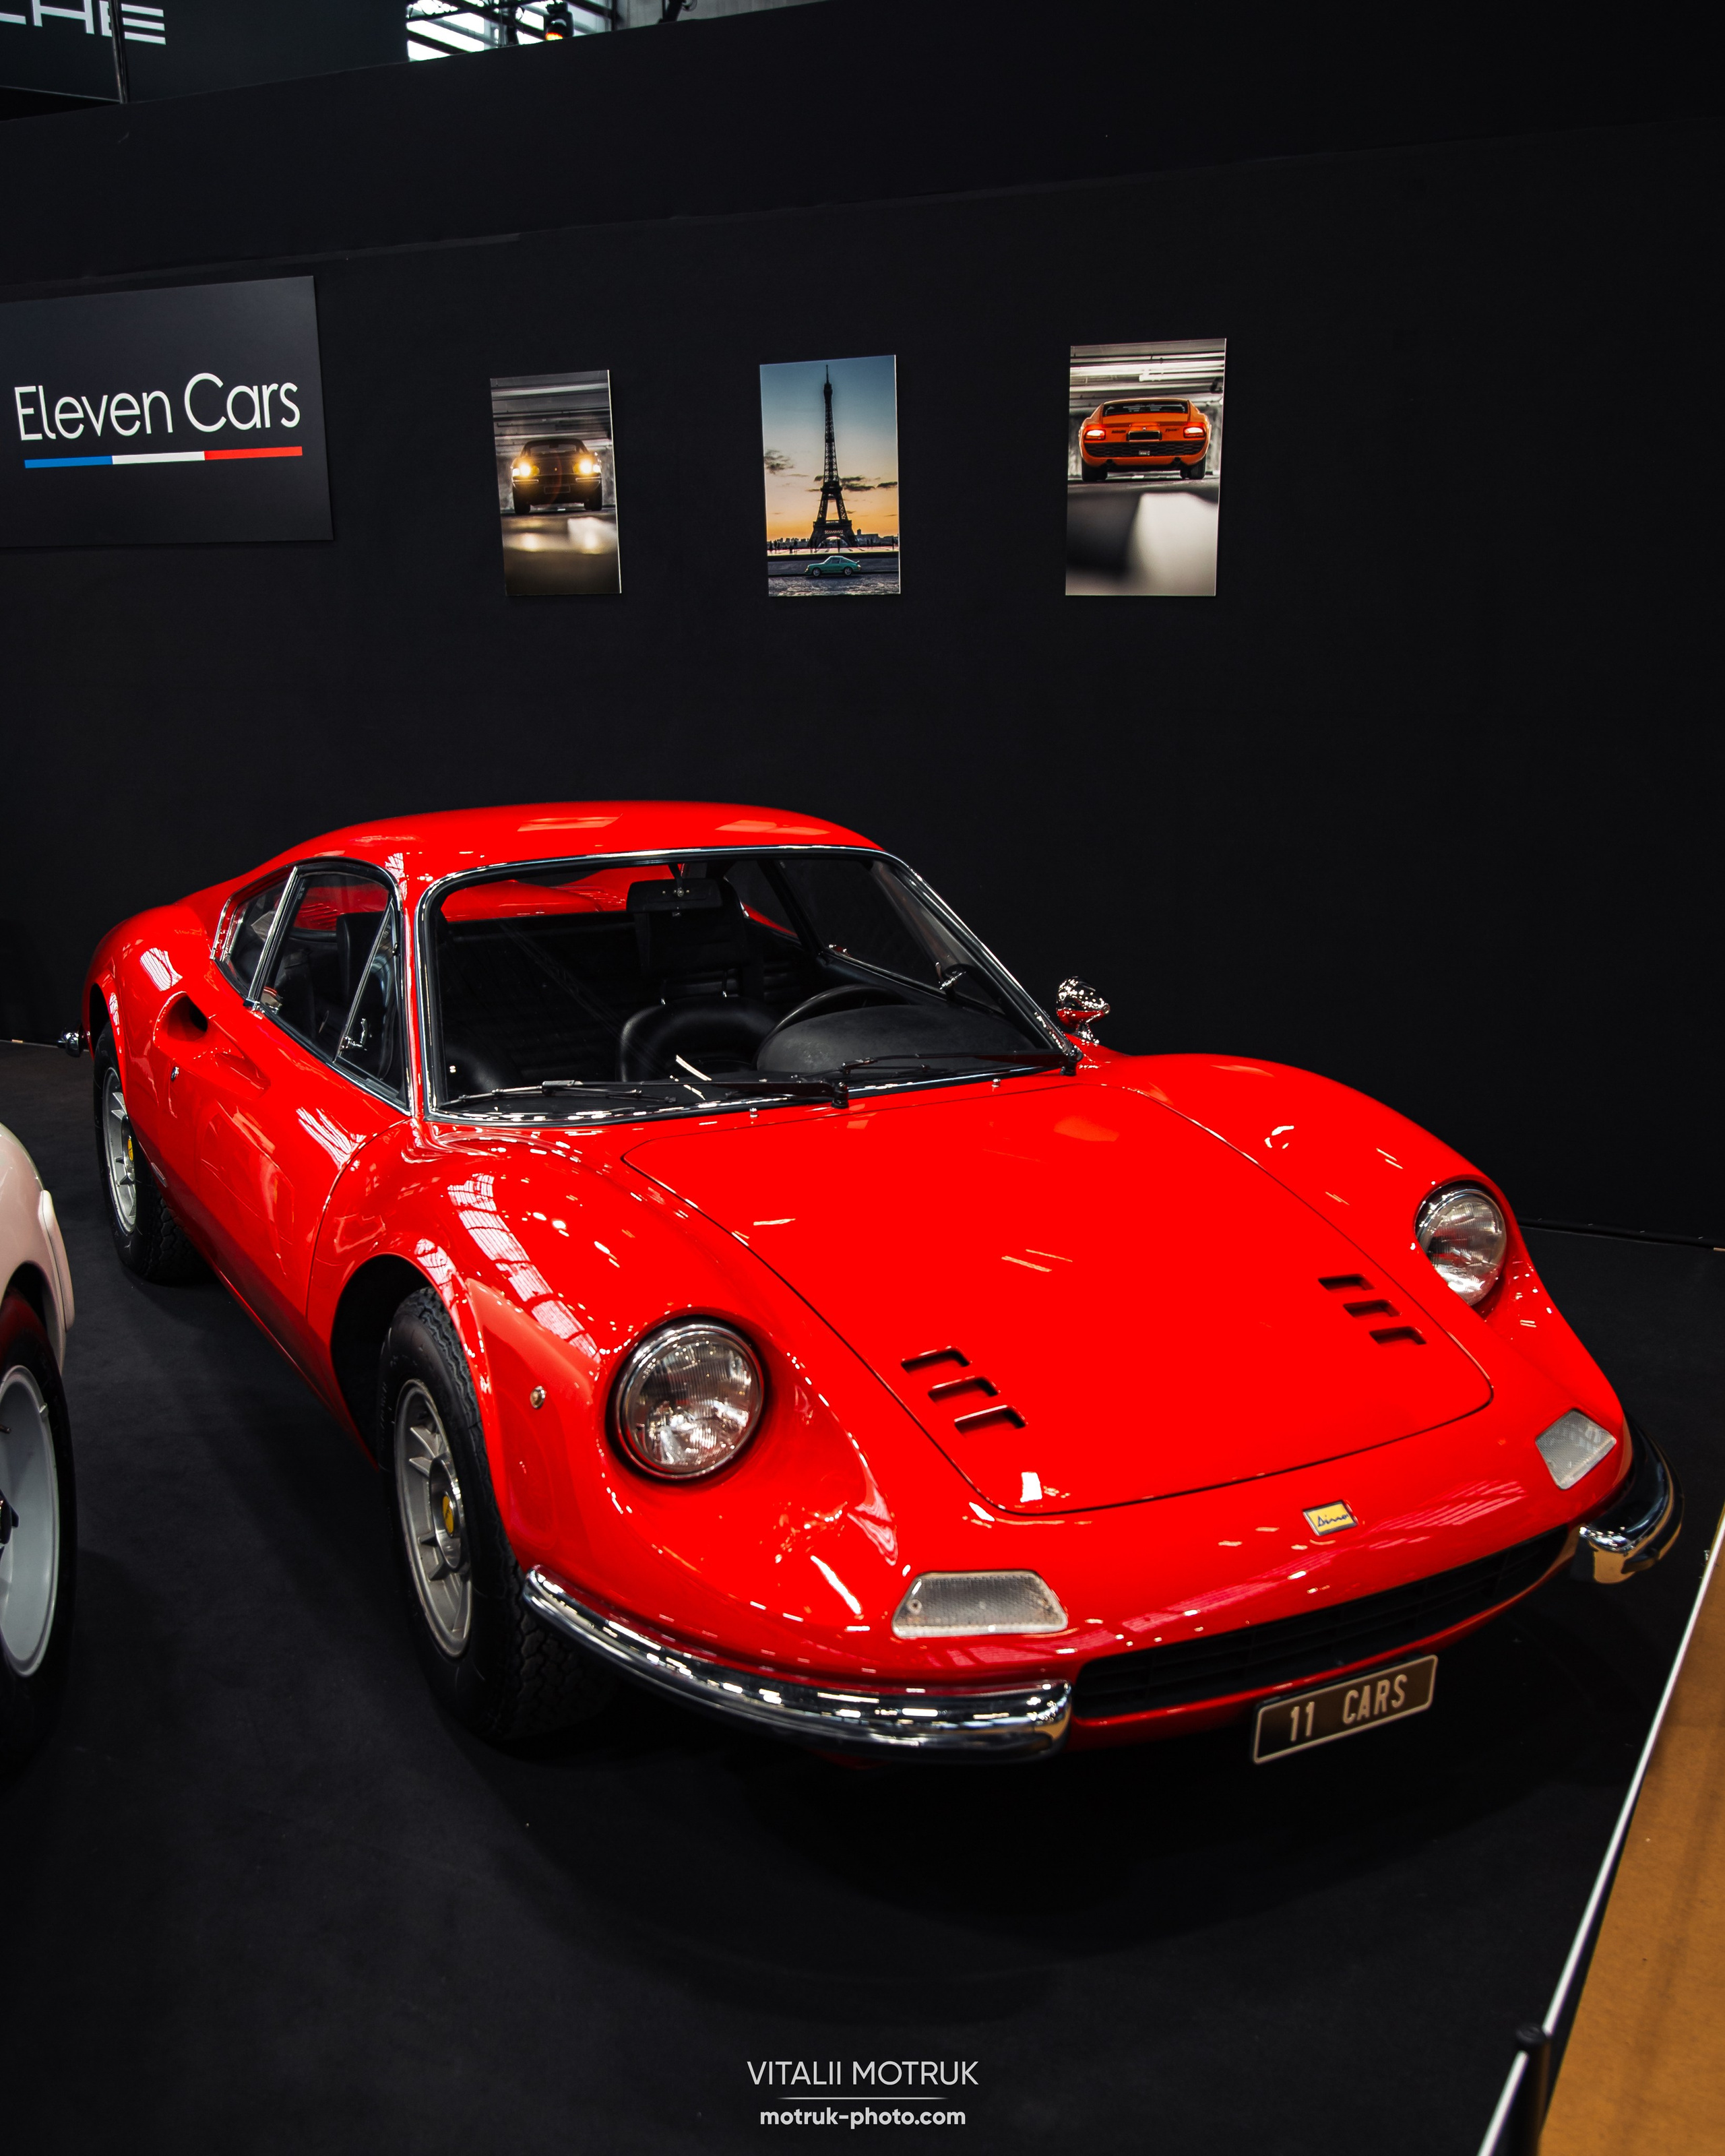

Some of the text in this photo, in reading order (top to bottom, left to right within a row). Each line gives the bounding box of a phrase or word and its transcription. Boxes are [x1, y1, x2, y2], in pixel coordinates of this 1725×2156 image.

[13, 372, 301, 441] Eleven Cars
[1290, 1674, 1408, 1742] 11 CARS
